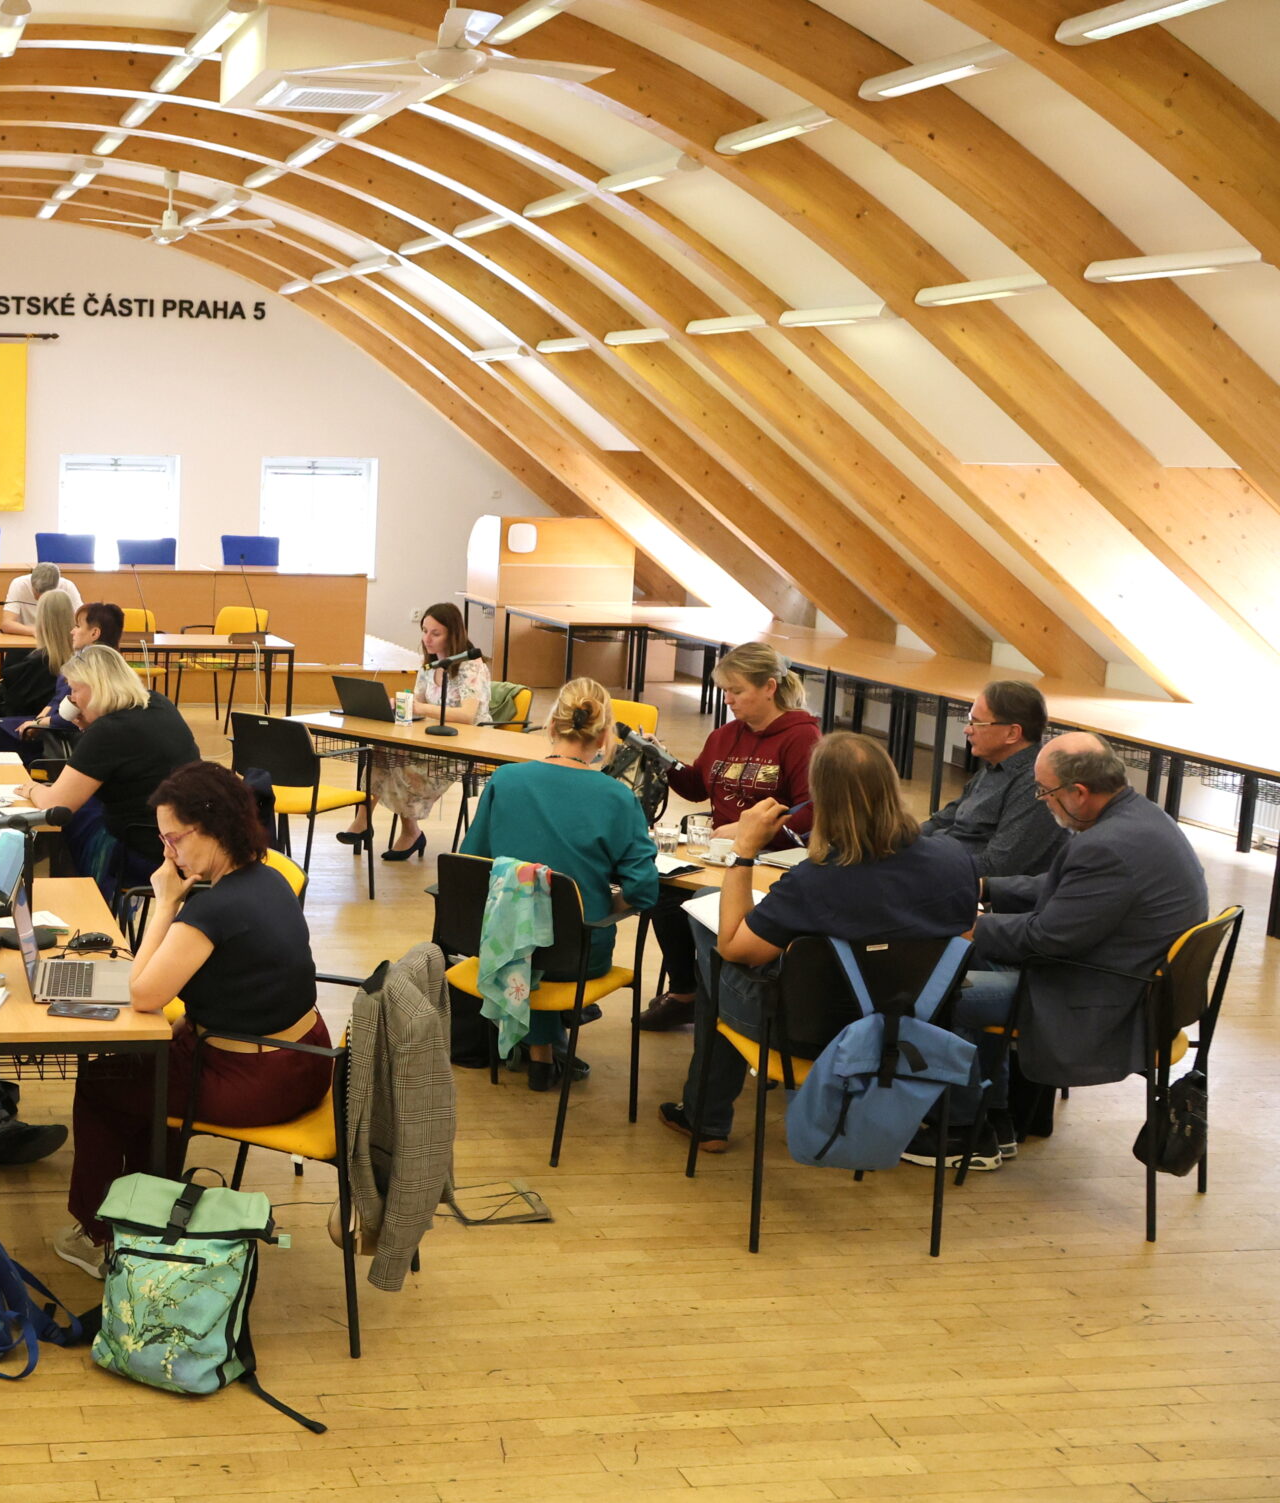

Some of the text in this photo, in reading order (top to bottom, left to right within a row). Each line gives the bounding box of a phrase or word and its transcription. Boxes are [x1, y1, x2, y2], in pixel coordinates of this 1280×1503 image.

[83, 293, 155, 318] ČÁSTI
[163, 299, 247, 320] PRAHA
[253, 301, 266, 320] 5
